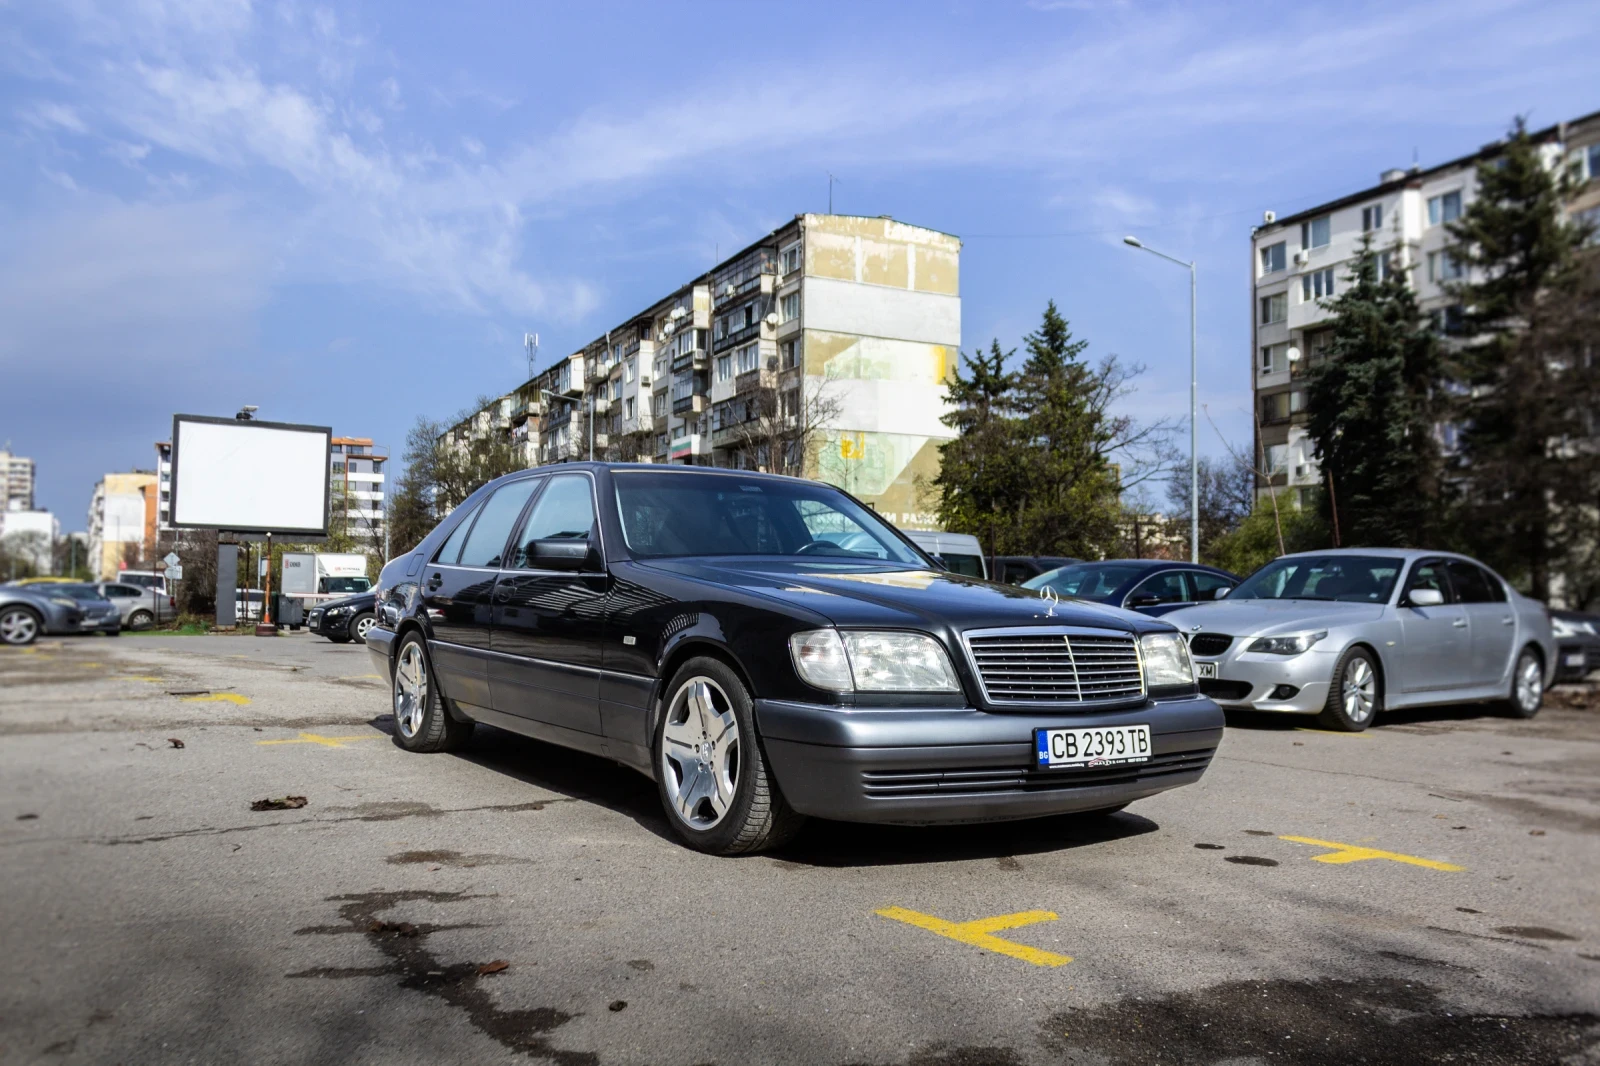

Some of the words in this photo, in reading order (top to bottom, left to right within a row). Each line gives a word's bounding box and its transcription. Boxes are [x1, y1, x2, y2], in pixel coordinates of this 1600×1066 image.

[1199, 665, 1213, 677] XM
[1052, 733, 1078, 759] CB
[1082, 730, 1126, 758] 2393
[1127, 728, 1148, 754] TB
[1038, 751, 1049, 760] BG
